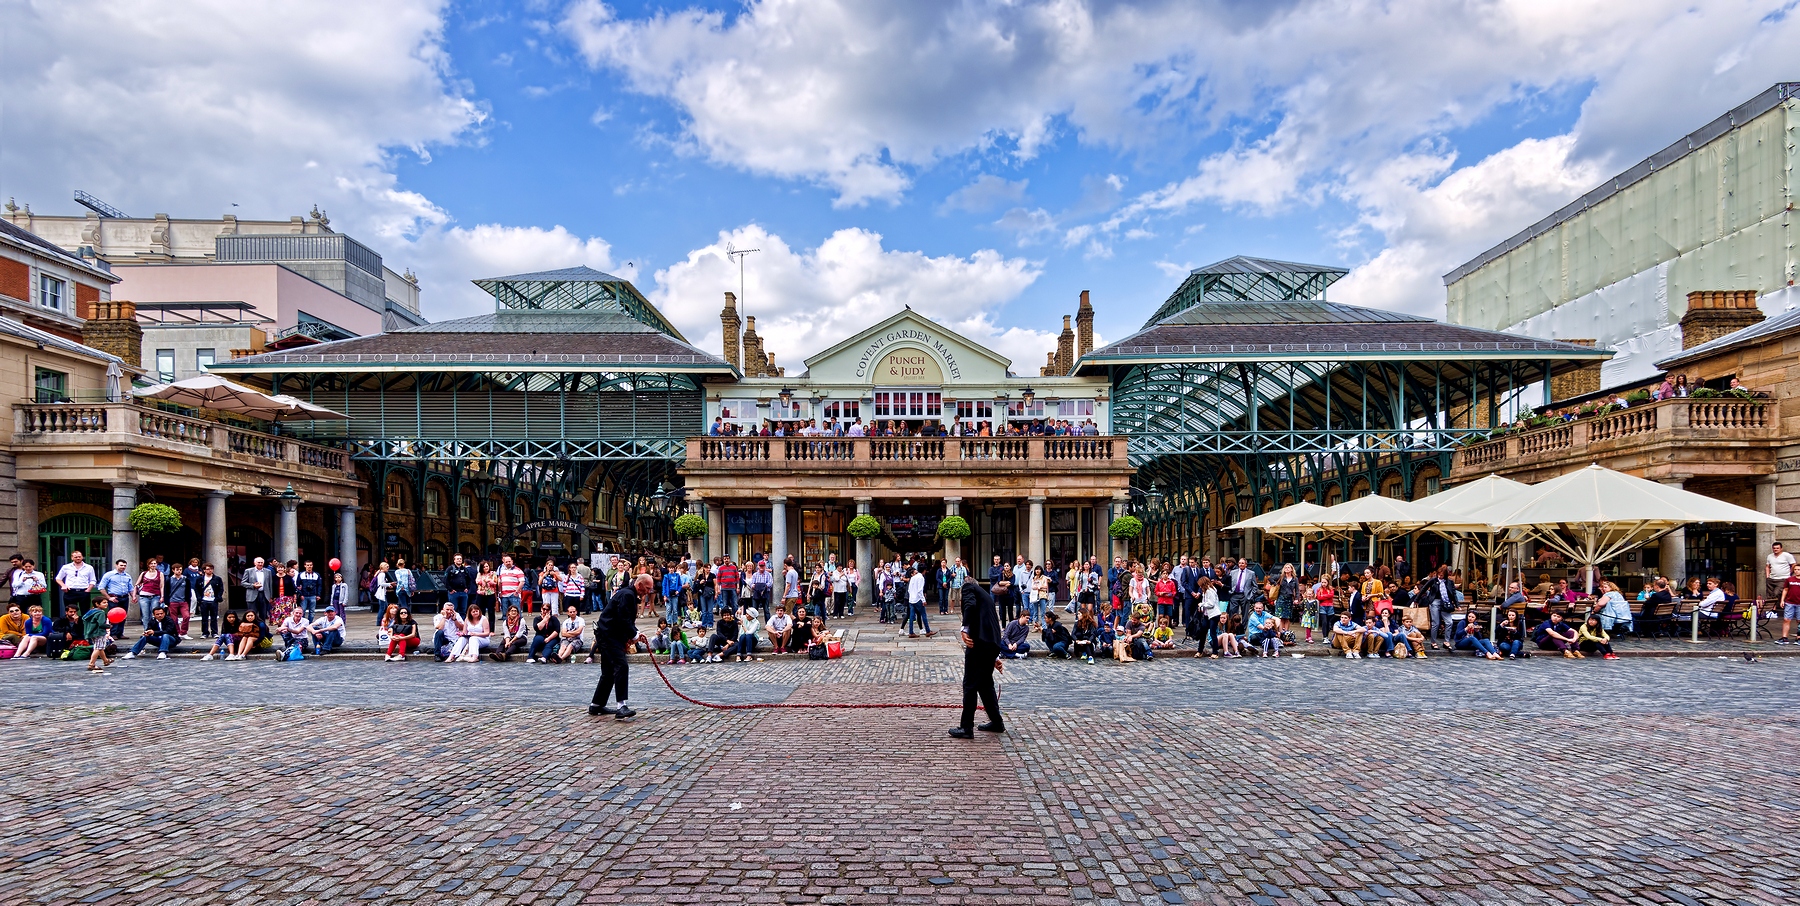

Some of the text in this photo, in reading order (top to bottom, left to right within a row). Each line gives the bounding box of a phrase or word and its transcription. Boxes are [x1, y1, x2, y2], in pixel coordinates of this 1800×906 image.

[856, 329, 961, 379] COVENT GARDEN MARKET
[890, 356, 925, 365] PUNCH
[890, 366, 925, 377] & JUDY
[525, 520, 578, 531] APPLE MARKET
